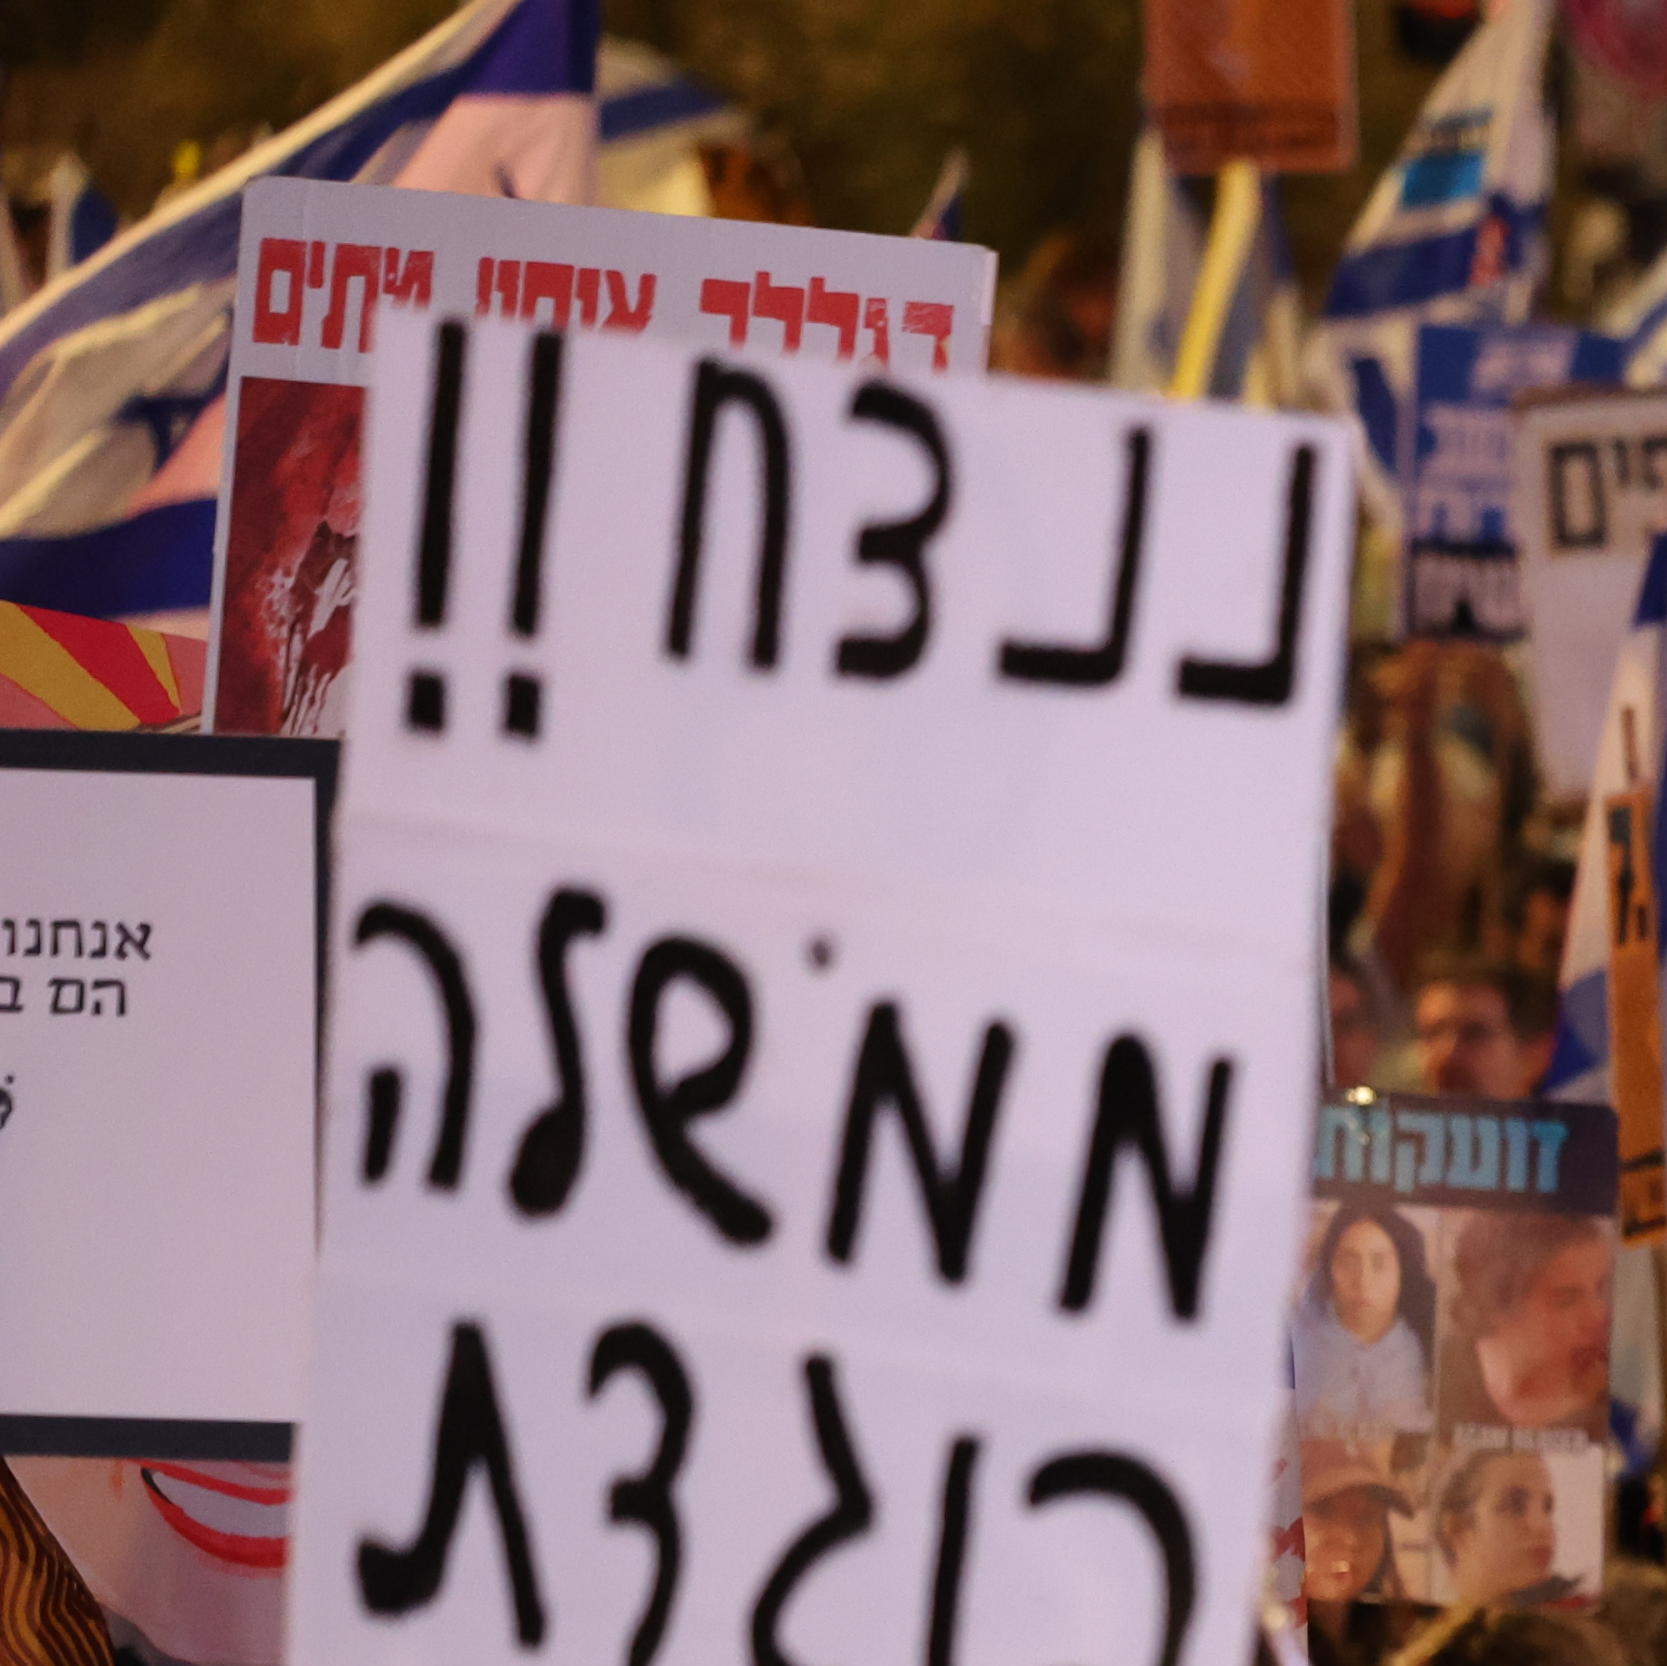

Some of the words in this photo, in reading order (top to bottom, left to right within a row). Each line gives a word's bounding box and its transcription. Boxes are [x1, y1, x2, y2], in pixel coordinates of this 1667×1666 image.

[1, 918, 153, 961] אנחנו
[48, 976, 128, 1017] הם
[352, 885, 1240, 1322] ממשלה
